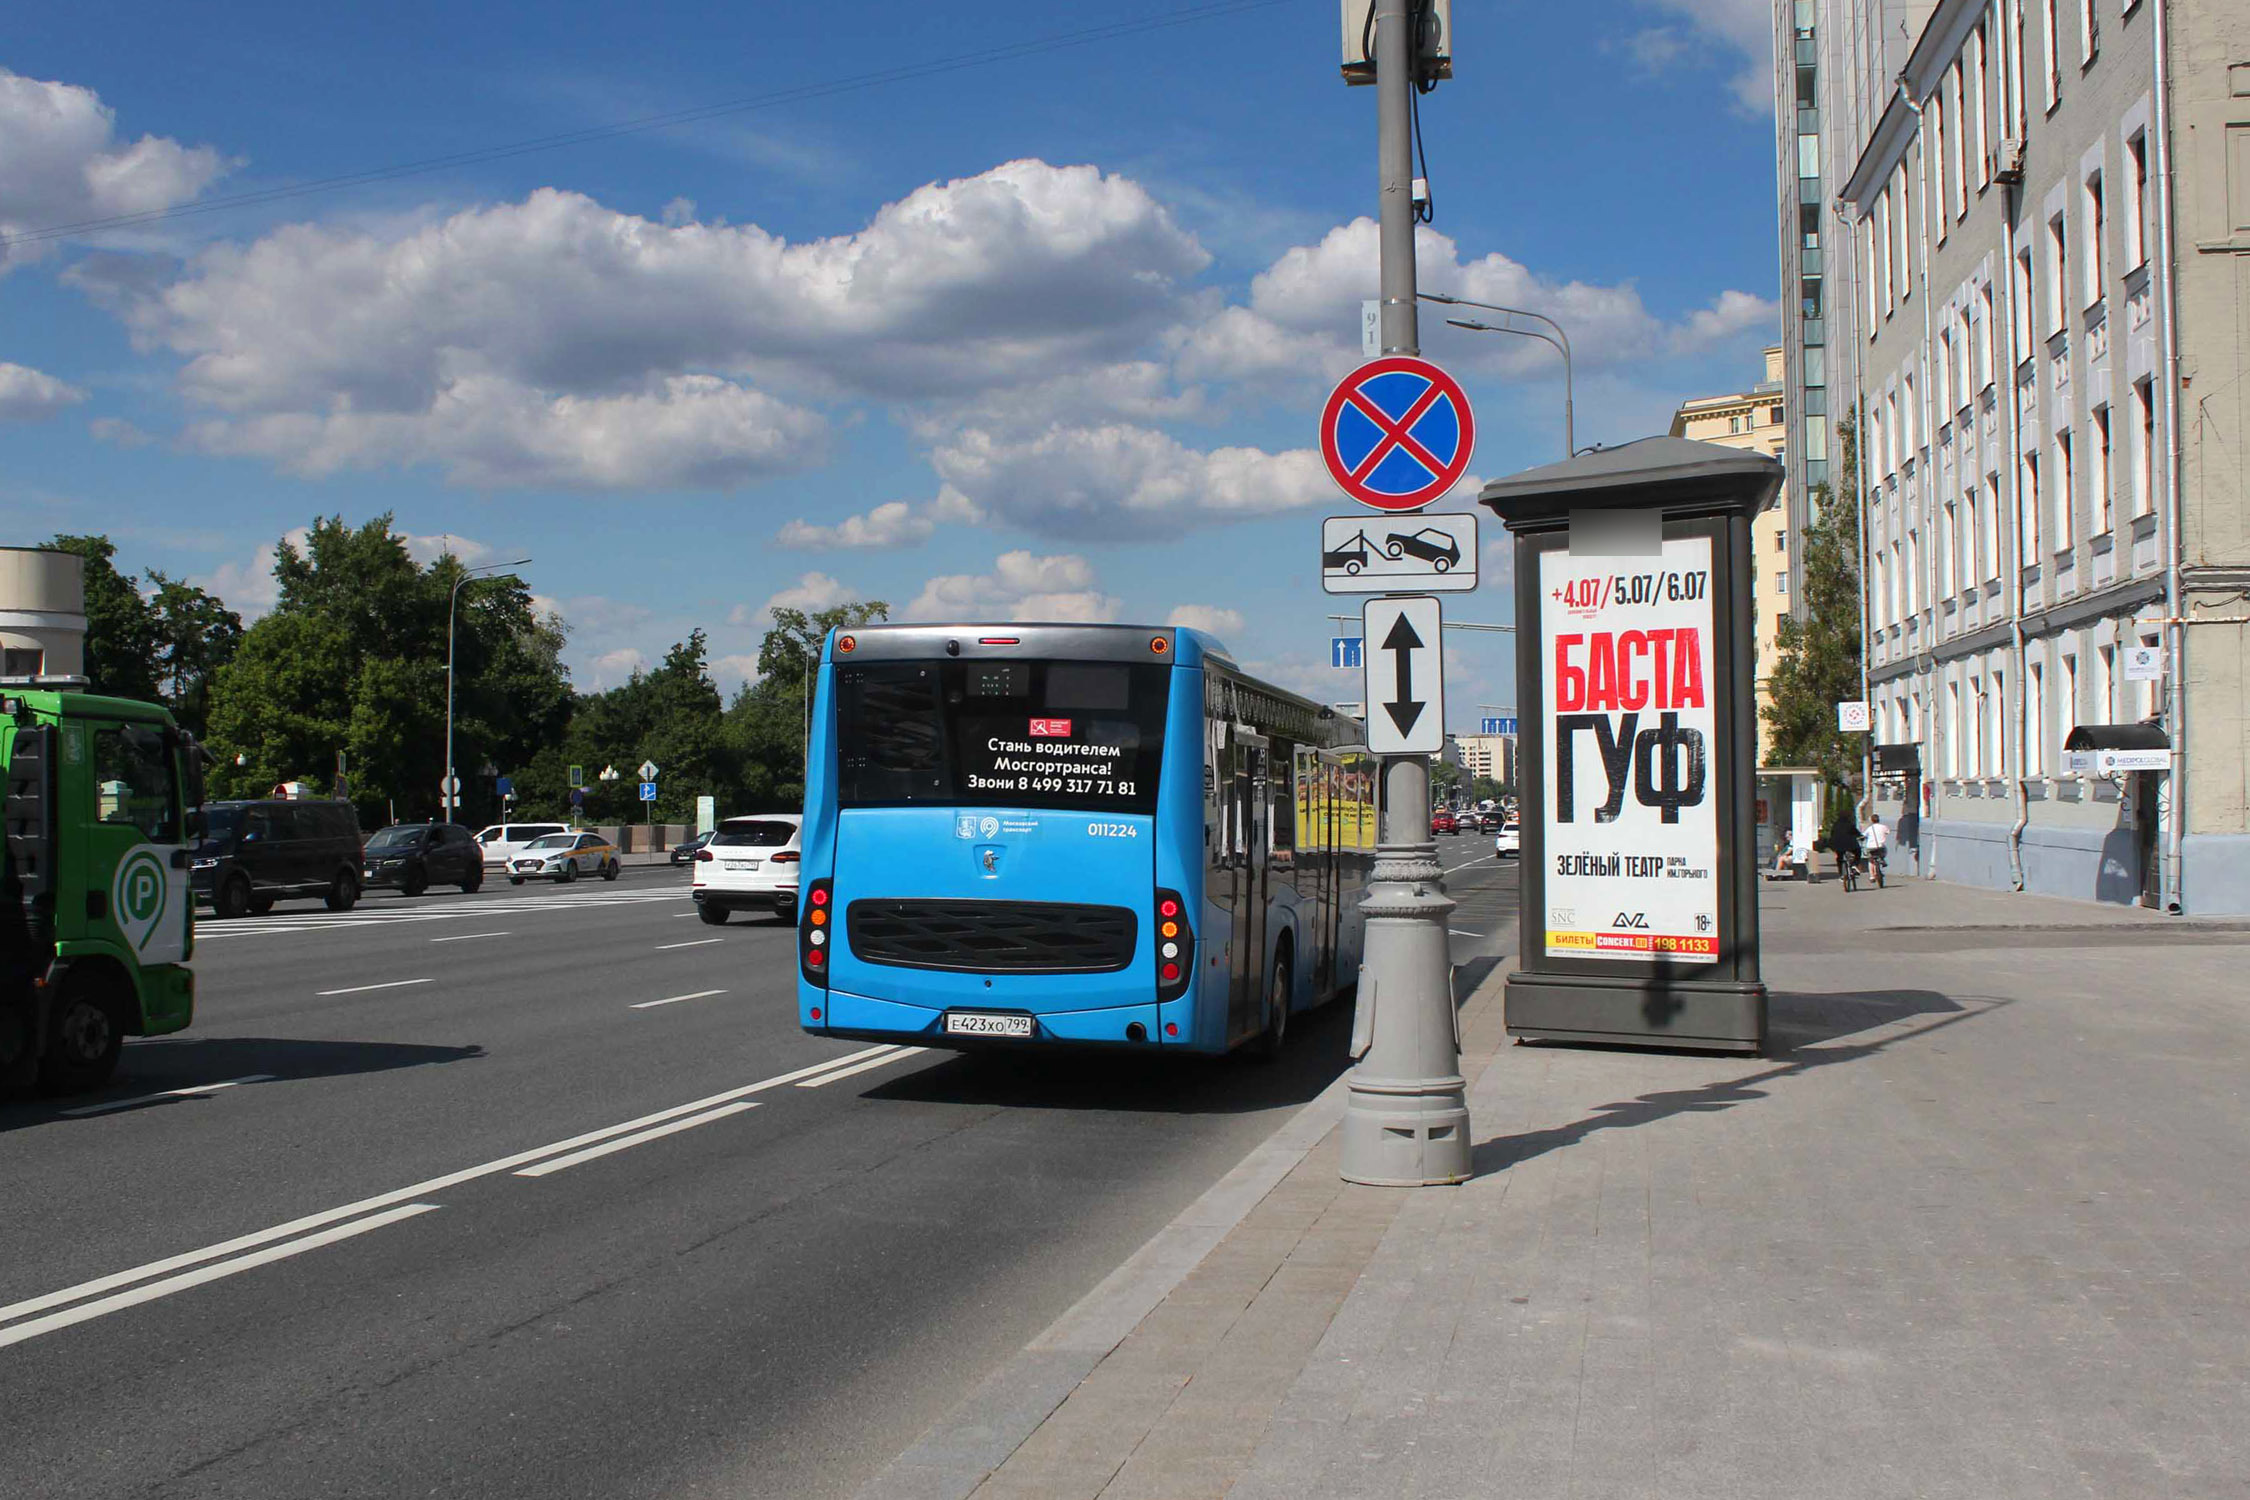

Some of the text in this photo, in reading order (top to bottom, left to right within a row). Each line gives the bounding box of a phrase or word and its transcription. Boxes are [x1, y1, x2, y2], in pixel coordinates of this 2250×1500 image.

[1555, 627, 1704, 712] БАСТА
[988, 738, 1121, 757] Стань водителем
[994, 757, 1112, 775] Мосгортранса!
[1556, 712, 1706, 824] ГУФ
[968, 774, 1136, 795] Звони 8 499 317 71 81
[1087, 823, 1137, 838] 011224
[1557, 851, 1663, 878] ЗЕЛЁНЫЙ ТЕАТР
[136, 875, 153, 911] P
[1552, 911, 1575, 924] SNC
[1695, 915, 1711, 931] 18+
[1555, 935, 1594, 945] БИЛЕТЫ
[1654, 937, 1677, 951] 198
[1680, 939, 1709, 952] 1133
